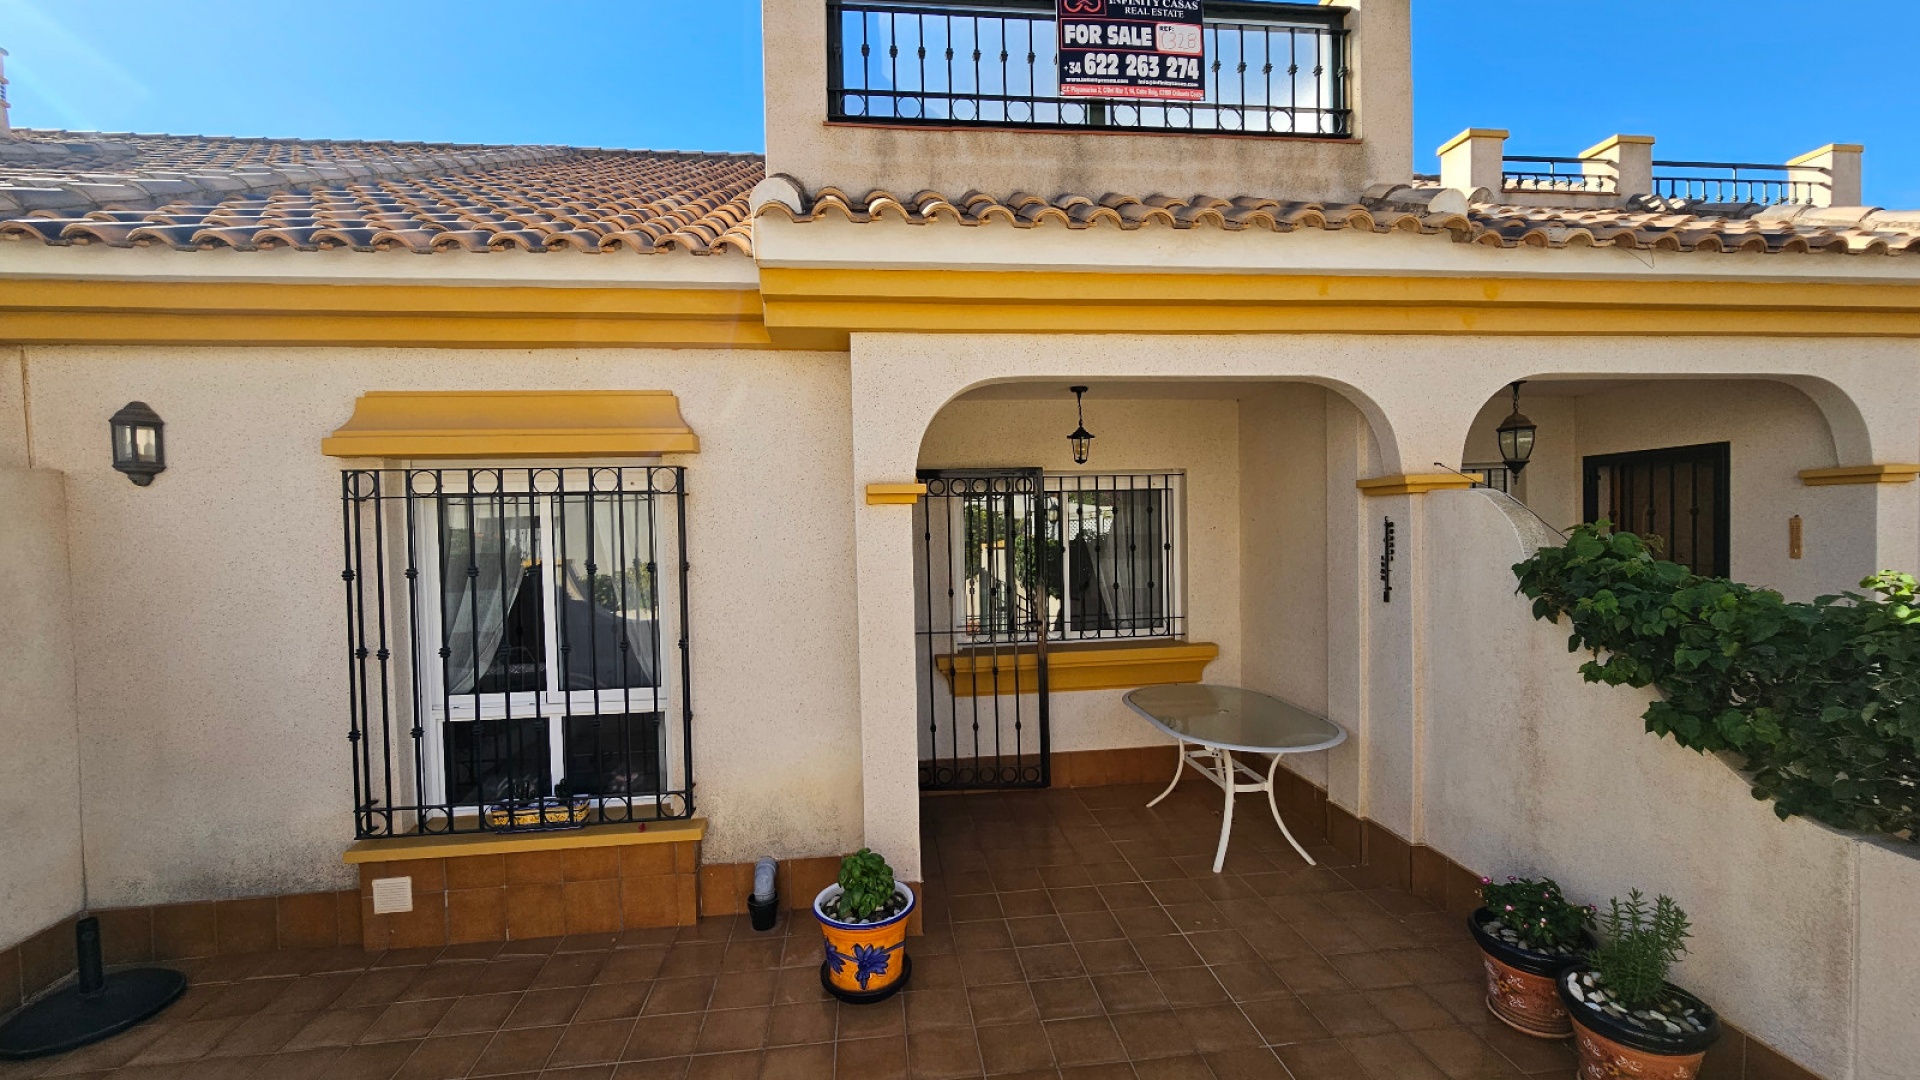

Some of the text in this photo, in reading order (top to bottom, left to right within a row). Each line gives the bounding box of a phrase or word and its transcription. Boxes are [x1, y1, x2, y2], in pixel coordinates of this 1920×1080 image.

[1125, 7, 1184, 18] REAL ESTATE
[1162, 0, 1199, 10] CASAS
[1064, 24, 1152, 46] FOR SALE
[1063, 52, 1199, 79] +34 622 263 274
